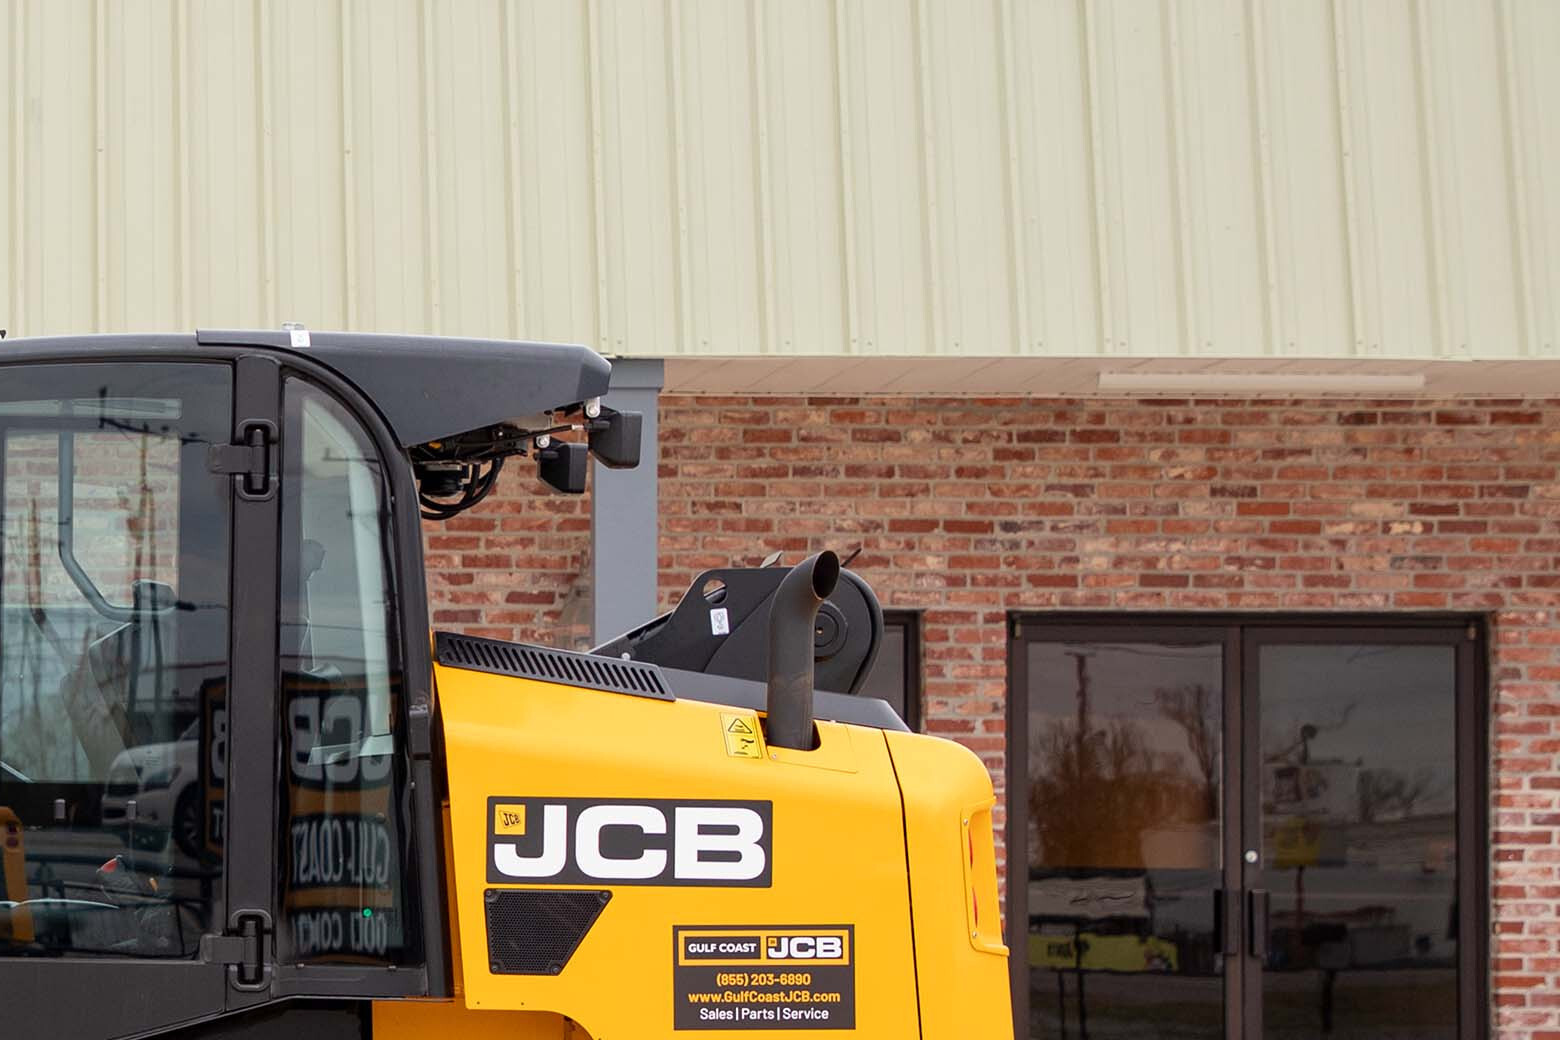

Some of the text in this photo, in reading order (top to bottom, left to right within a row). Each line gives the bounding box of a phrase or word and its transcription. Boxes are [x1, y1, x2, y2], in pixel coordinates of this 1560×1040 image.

[503, 812, 520, 827] JCB
[494, 804, 766, 880] JCB
[688, 943, 757, 953] GULF COAST
[767, 937, 842, 958] JCB
[716, 973, 811, 987] (855) 203-6890
[688, 990, 841, 1003] www.GulfCoastJCB.com
[700, 1007, 829, 1020] Sales Parts Service
